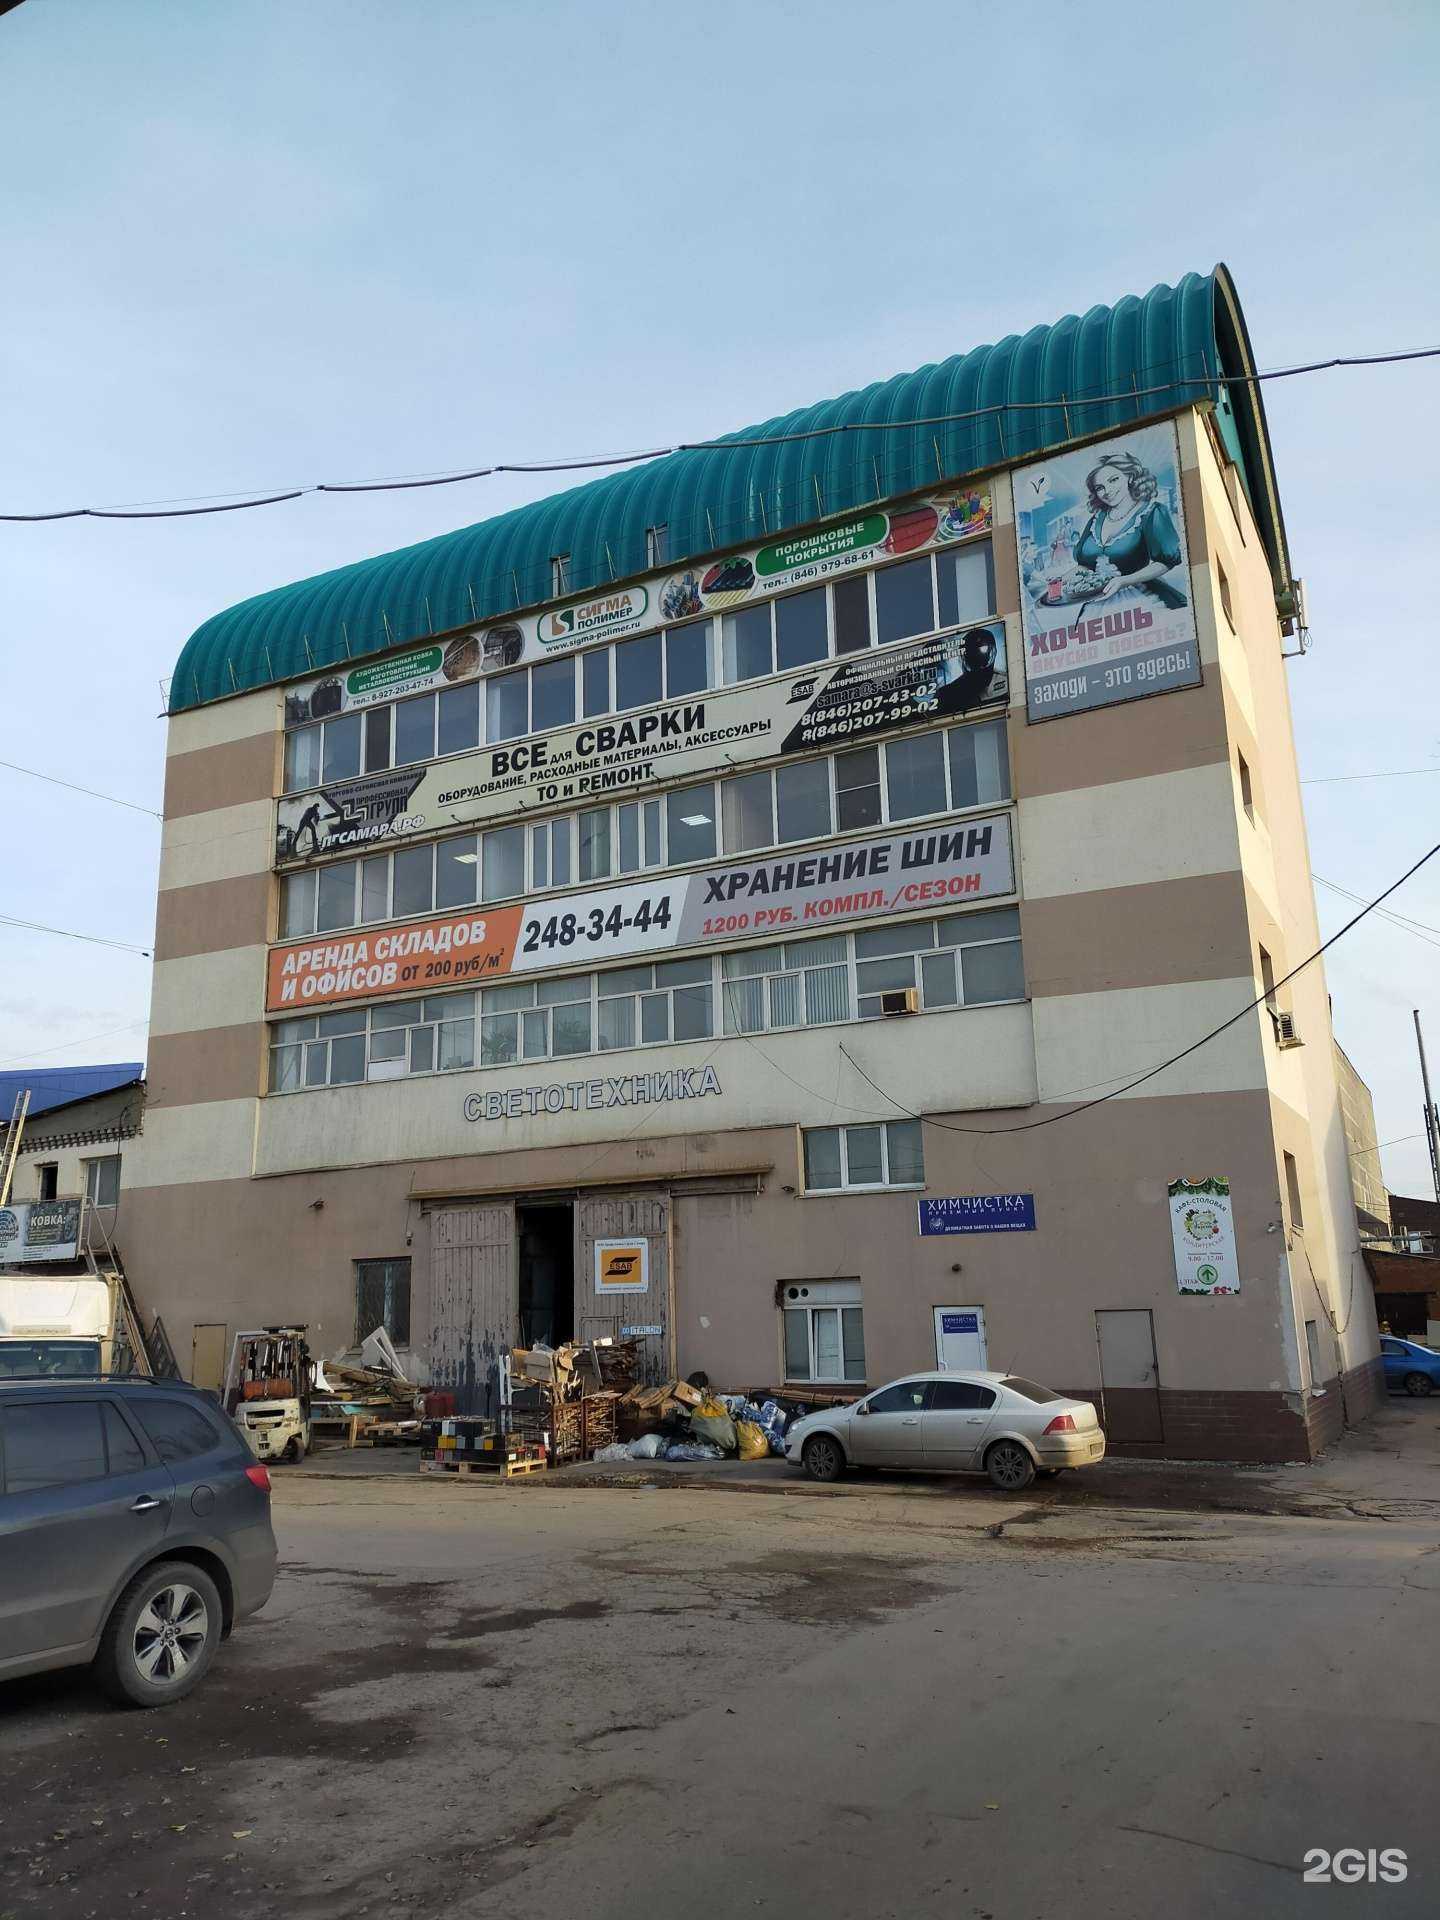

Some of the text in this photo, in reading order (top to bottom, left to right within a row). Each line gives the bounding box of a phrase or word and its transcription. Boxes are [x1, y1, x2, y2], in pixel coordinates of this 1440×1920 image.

[775, 522, 864, 557] ПОРОШКОВЫЕ
[786, 537, 854, 565] ПОКРЫТИЯ
[763, 550, 874, 590] тел.: (846) 979-68-61
[576, 594, 631, 620] СИГМА
[578, 607, 633, 630] ПОЛИМЕР
[546, 621, 640, 653] www.sigma-polimer.ru
[1031, 607, 1153, 657] ХОЧЕШЬ
[356, 651, 433, 678] ХУДОЖЕСТВЕННАЯ КОВКА
[370, 663, 418, 681] ИЗГОТОВЛЕНИЕ
[827, 666, 895, 690] АВТОРИЗОВАННЫЙ
[895, 654, 941, 672] СЕРВИСНЫЙ
[845, 638, 965, 675] ОФИЦИАЛЬНЫЙ ПРЕДСТАВИТЕЛЬ
[358, 665, 431, 691] МЕТАЛЛОКОНСТРУКЦИЙ
[371, 678, 434, 702] 8-927-203-47-74
[791, 684, 815, 697] ESAB
[816, 667, 937, 707] samara@s-svarka.ru
[801, 683, 937, 726] 8(846)207-43-02
[802, 698, 939, 742] 8(846)207-99-02
[491, 742, 548, 777] ВСЕ
[576, 704, 706, 756] СВАРКИ
[438, 719, 771, 804] ОБОРУДОВАНИЕ, РАСХОДНЫЕ МАТЕРИАЛЫ, АКСЕССУАРЫ
[356, 787, 409, 806] ПРОФЕССИОНАЛ
[537, 785, 558, 802] ТО
[579, 762, 653, 795] РЕМОНТ
[370, 796, 408, 820] ГРУПП
[703, 826, 992, 904] ХРАНЕНИЕ ШИН
[702, 873, 981, 936] 1200 РУБ. КОМПЛ./СЕЗОН
[522, 895, 671, 953] 248-34-44
[281, 920, 486, 976] АРЕНДА СКЛАДОВ
[281, 978, 297, 1001] И
[302, 963, 398, 998] ОФИСОВ
[425, 961, 451, 979] 200
[464, 1065, 722, 1122] СВЕТОТЕХНИКА
[31, 1214, 66, 1227] КОВКА:
[928, 1195, 1025, 1211] ХИМЧИСТКА
[1175, 1197, 1227, 1214] КАФЕ-СТОЛОВАЯ
[609, 1262, 633, 1270] ESAB
